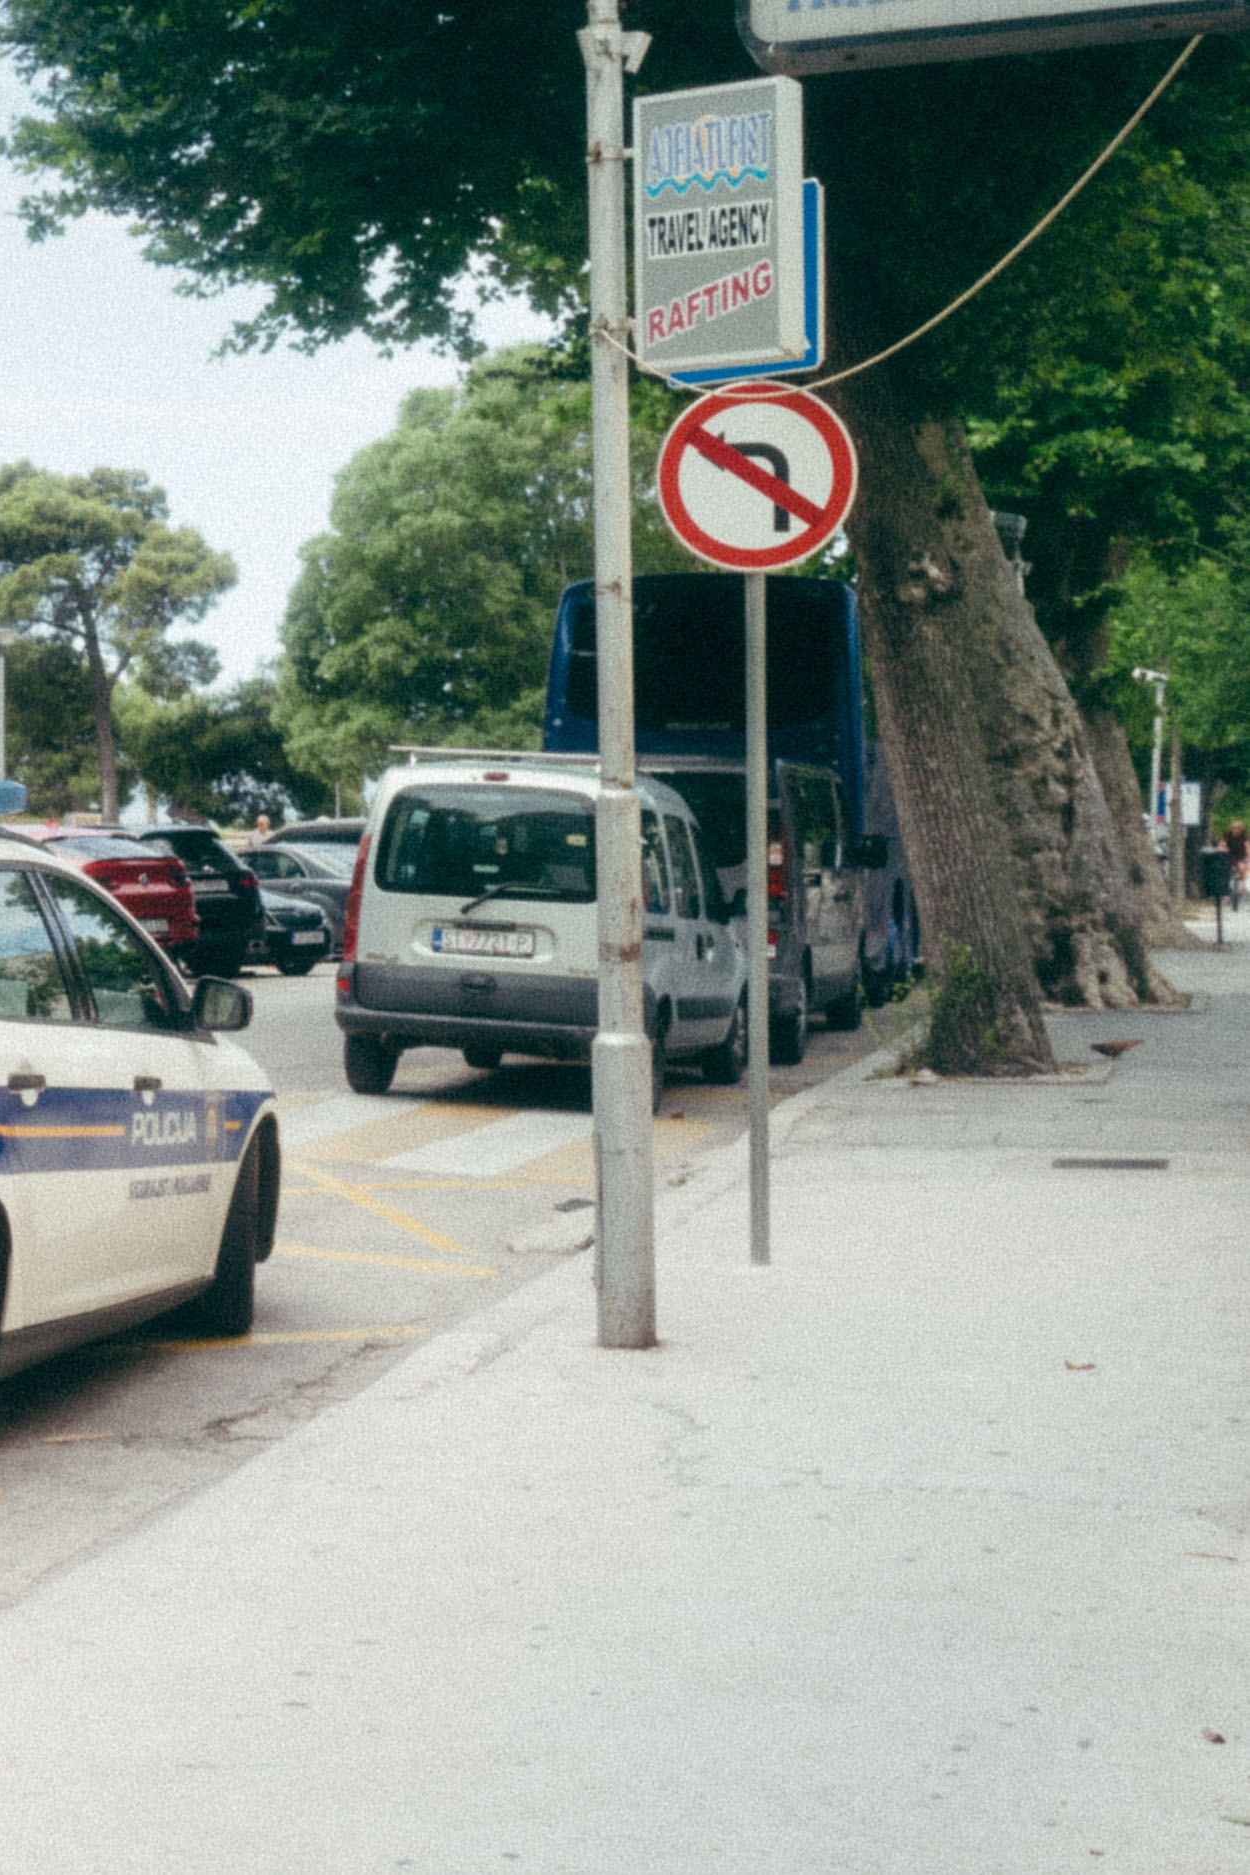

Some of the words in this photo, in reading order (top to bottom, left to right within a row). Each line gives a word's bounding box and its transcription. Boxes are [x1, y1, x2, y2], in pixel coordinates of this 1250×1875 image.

[647, 210, 704, 256] TRAVEL
[708, 203, 770, 249] AGENCY
[648, 260, 772, 344] RAFTING
[131, 1111, 198, 1147] POLICIJA
